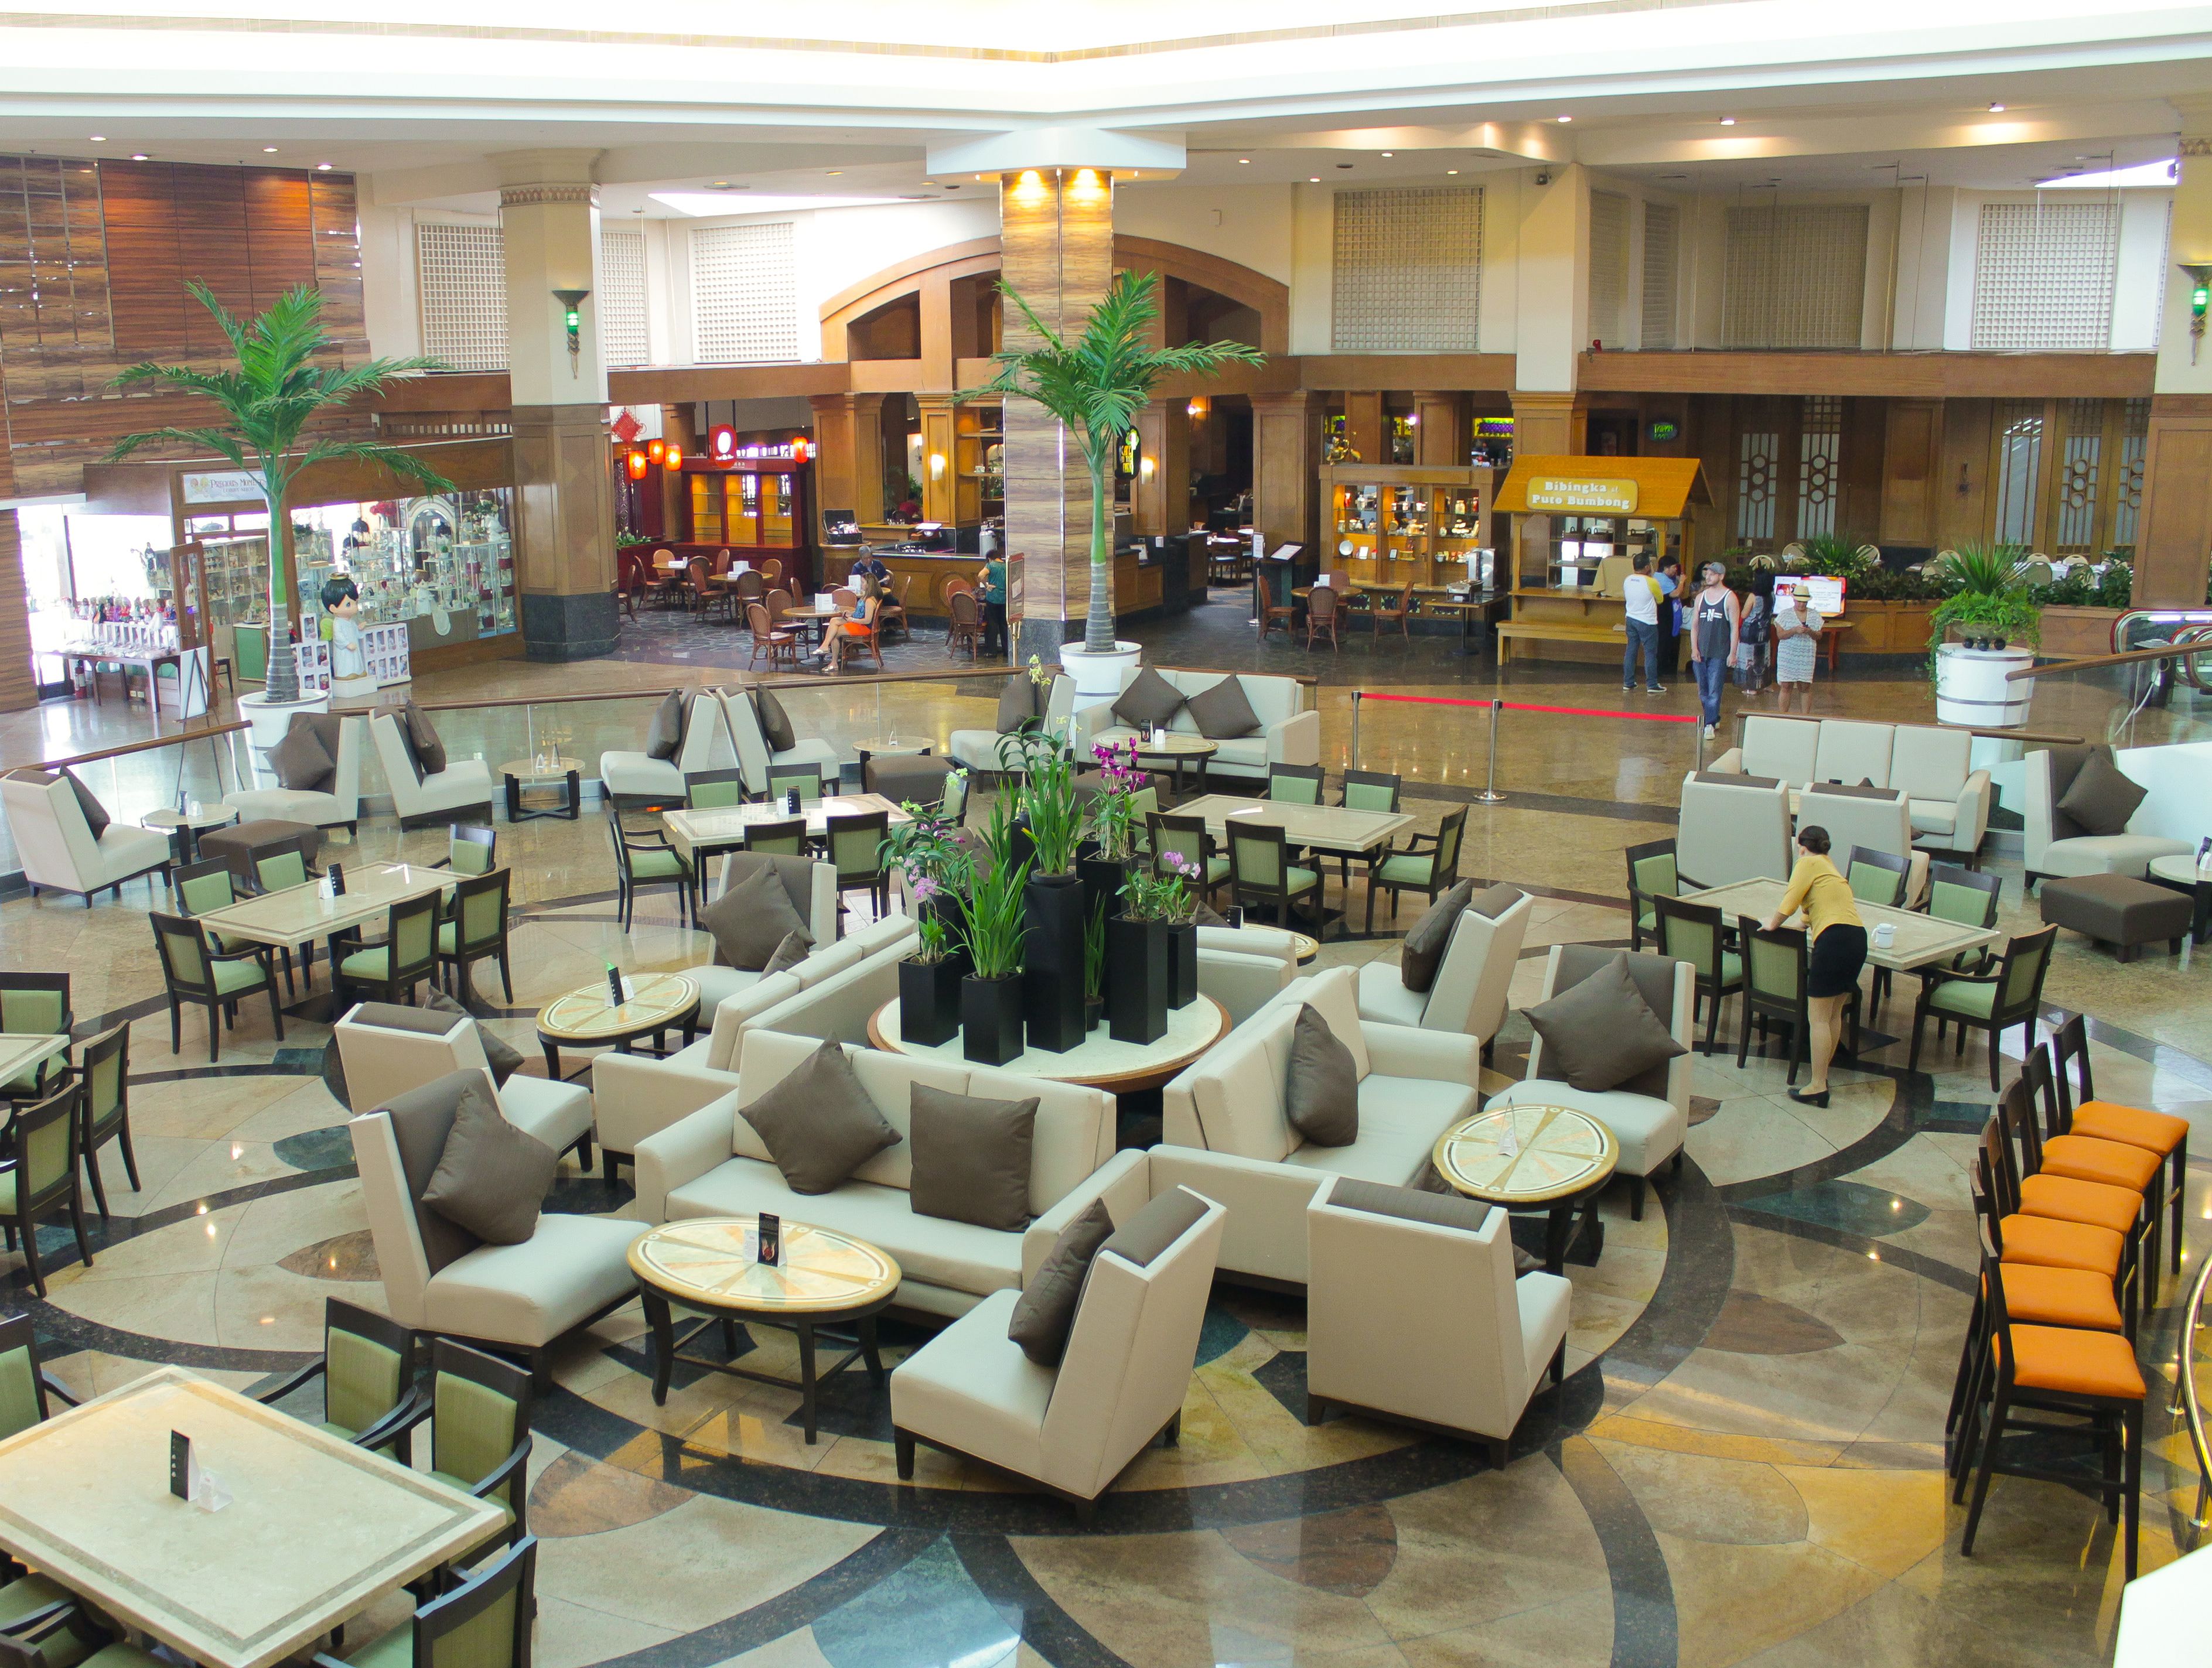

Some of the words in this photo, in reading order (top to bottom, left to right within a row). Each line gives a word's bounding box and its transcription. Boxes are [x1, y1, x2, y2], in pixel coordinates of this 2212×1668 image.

[1545, 481, 1607, 494] Bibingka
[1532, 494, 1563, 504] Puto
[1568, 496, 1630, 510] Bumbong
